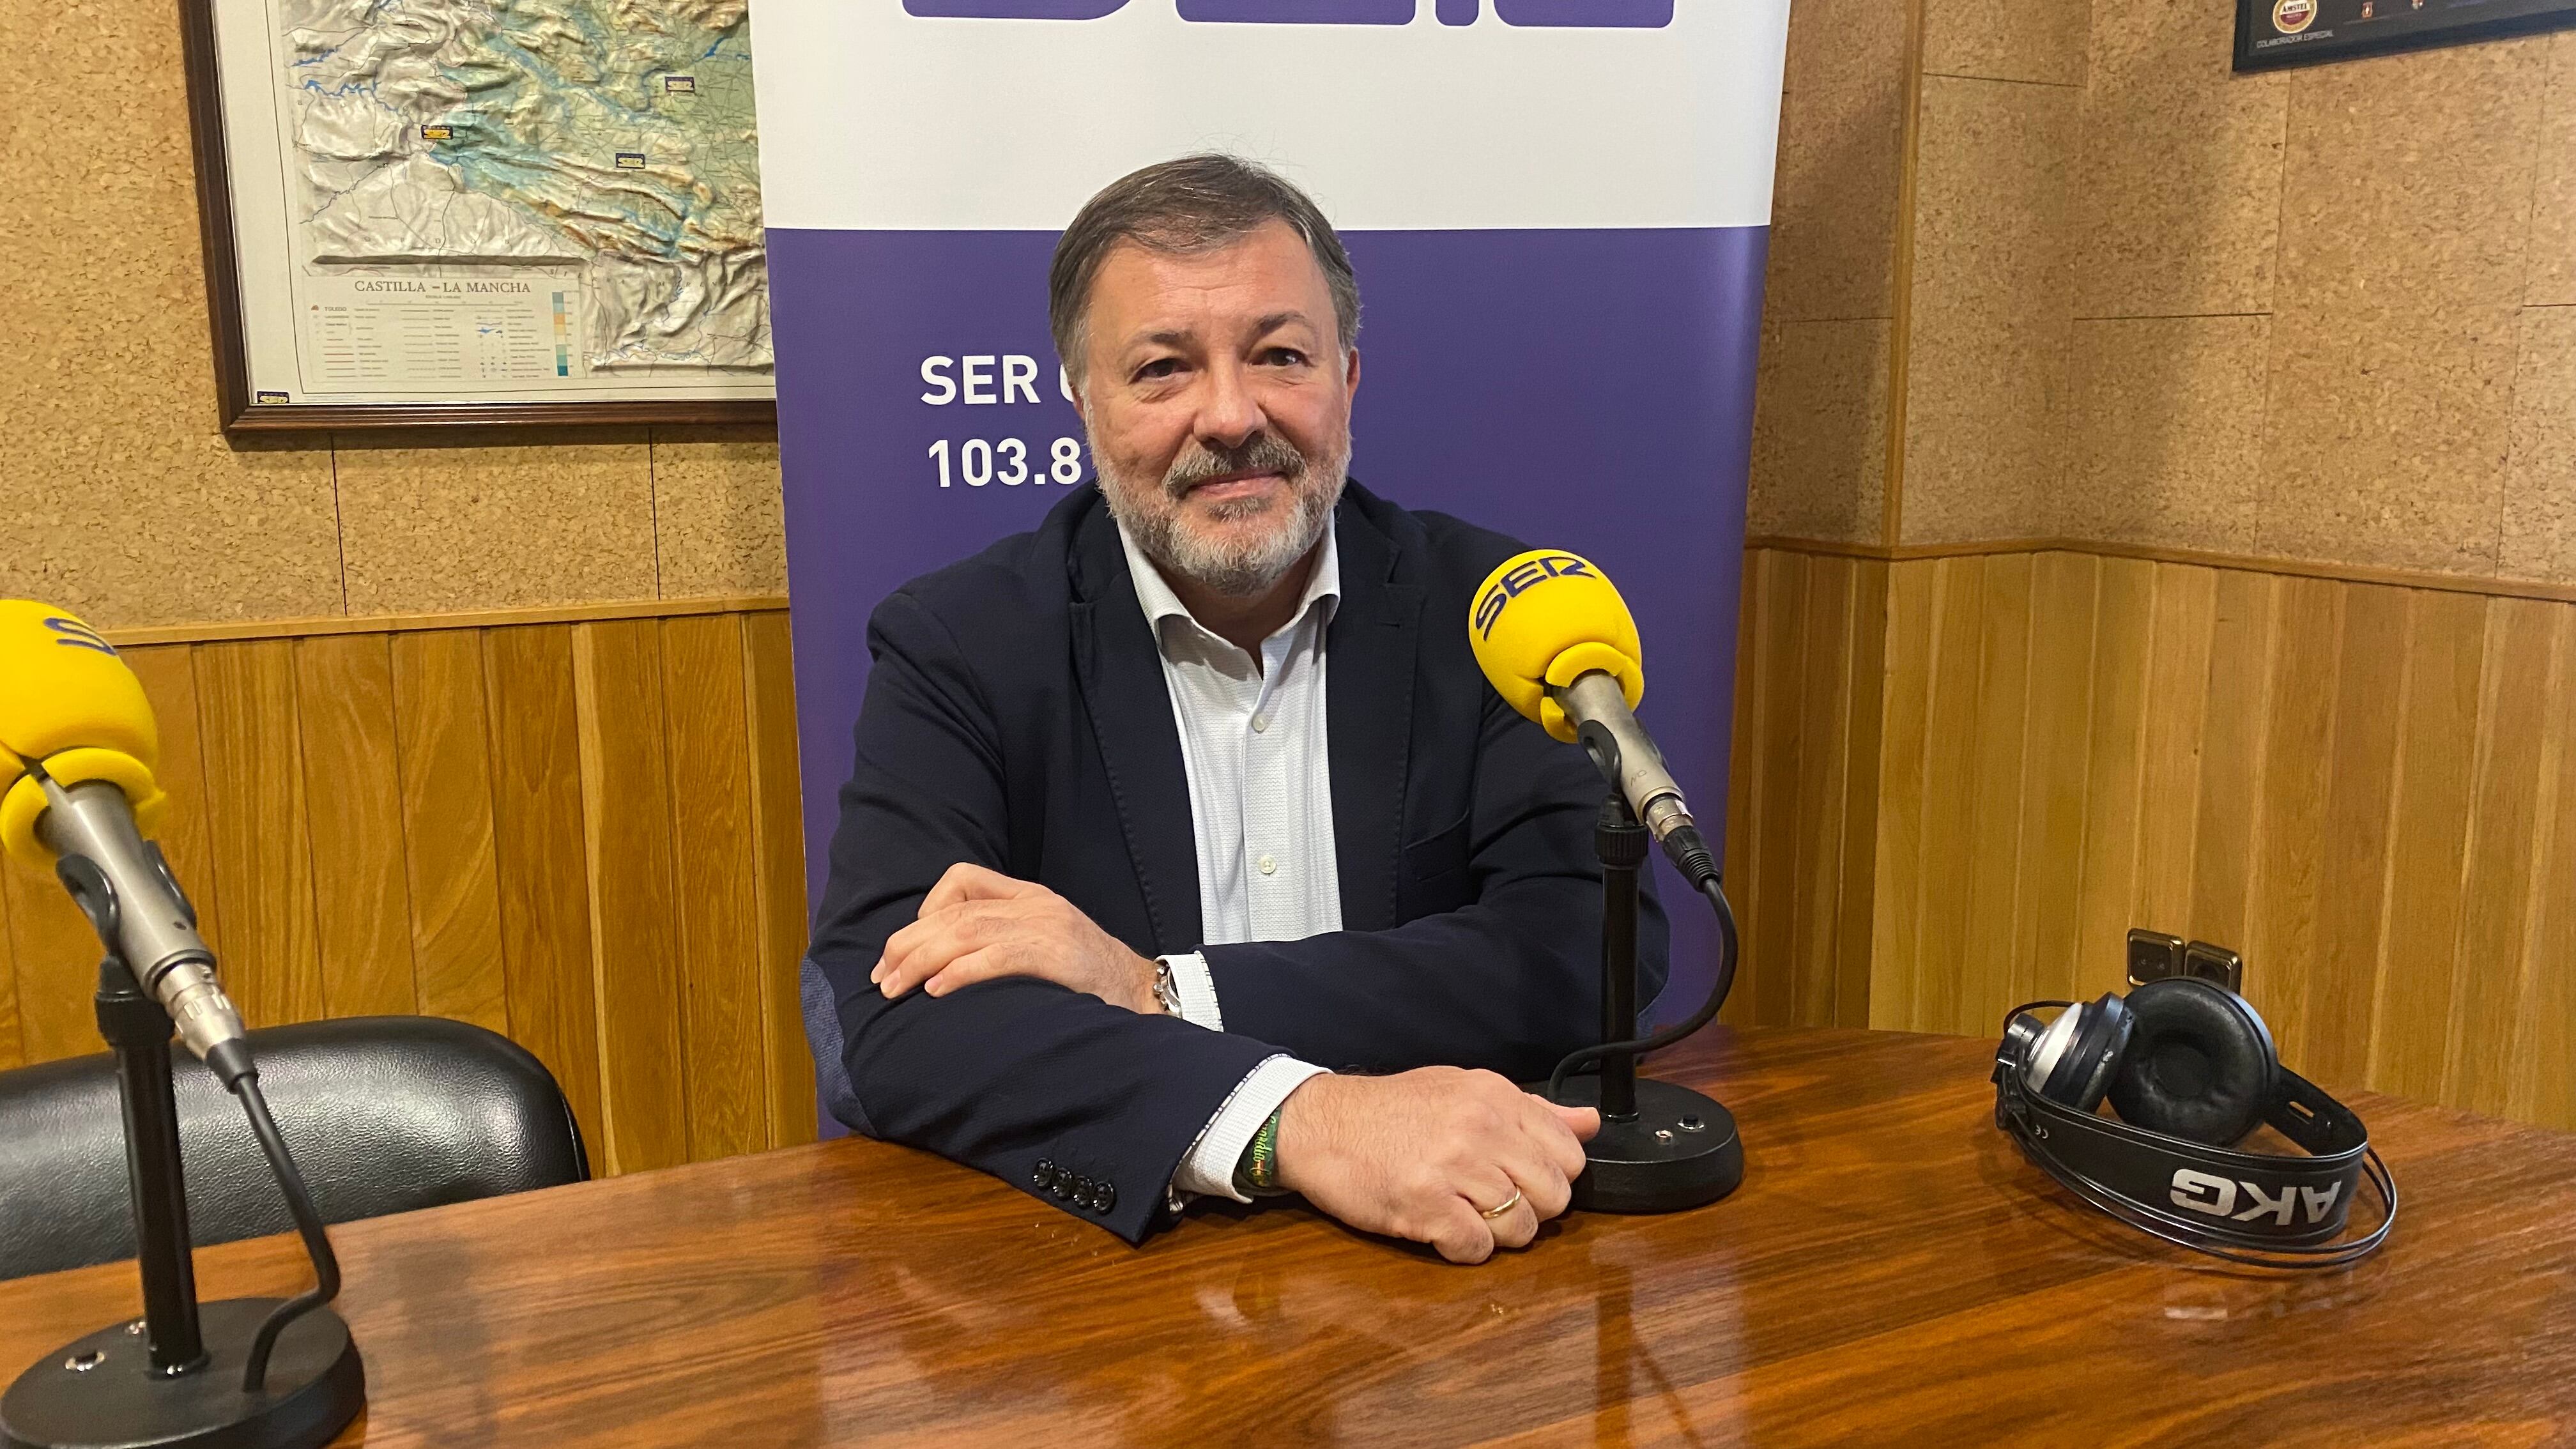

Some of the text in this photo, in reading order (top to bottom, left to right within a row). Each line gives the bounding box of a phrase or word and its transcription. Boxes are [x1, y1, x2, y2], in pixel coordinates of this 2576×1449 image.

[354, 280, 426, 293] CASTILLA
[466, 282, 532, 293] MANCHA
[920, 355, 1041, 406] SER
[928, 437, 1082, 487] 103.8
[1475, 556, 1597, 641] SER
[2169, 1169, 2342, 1226] AKG
